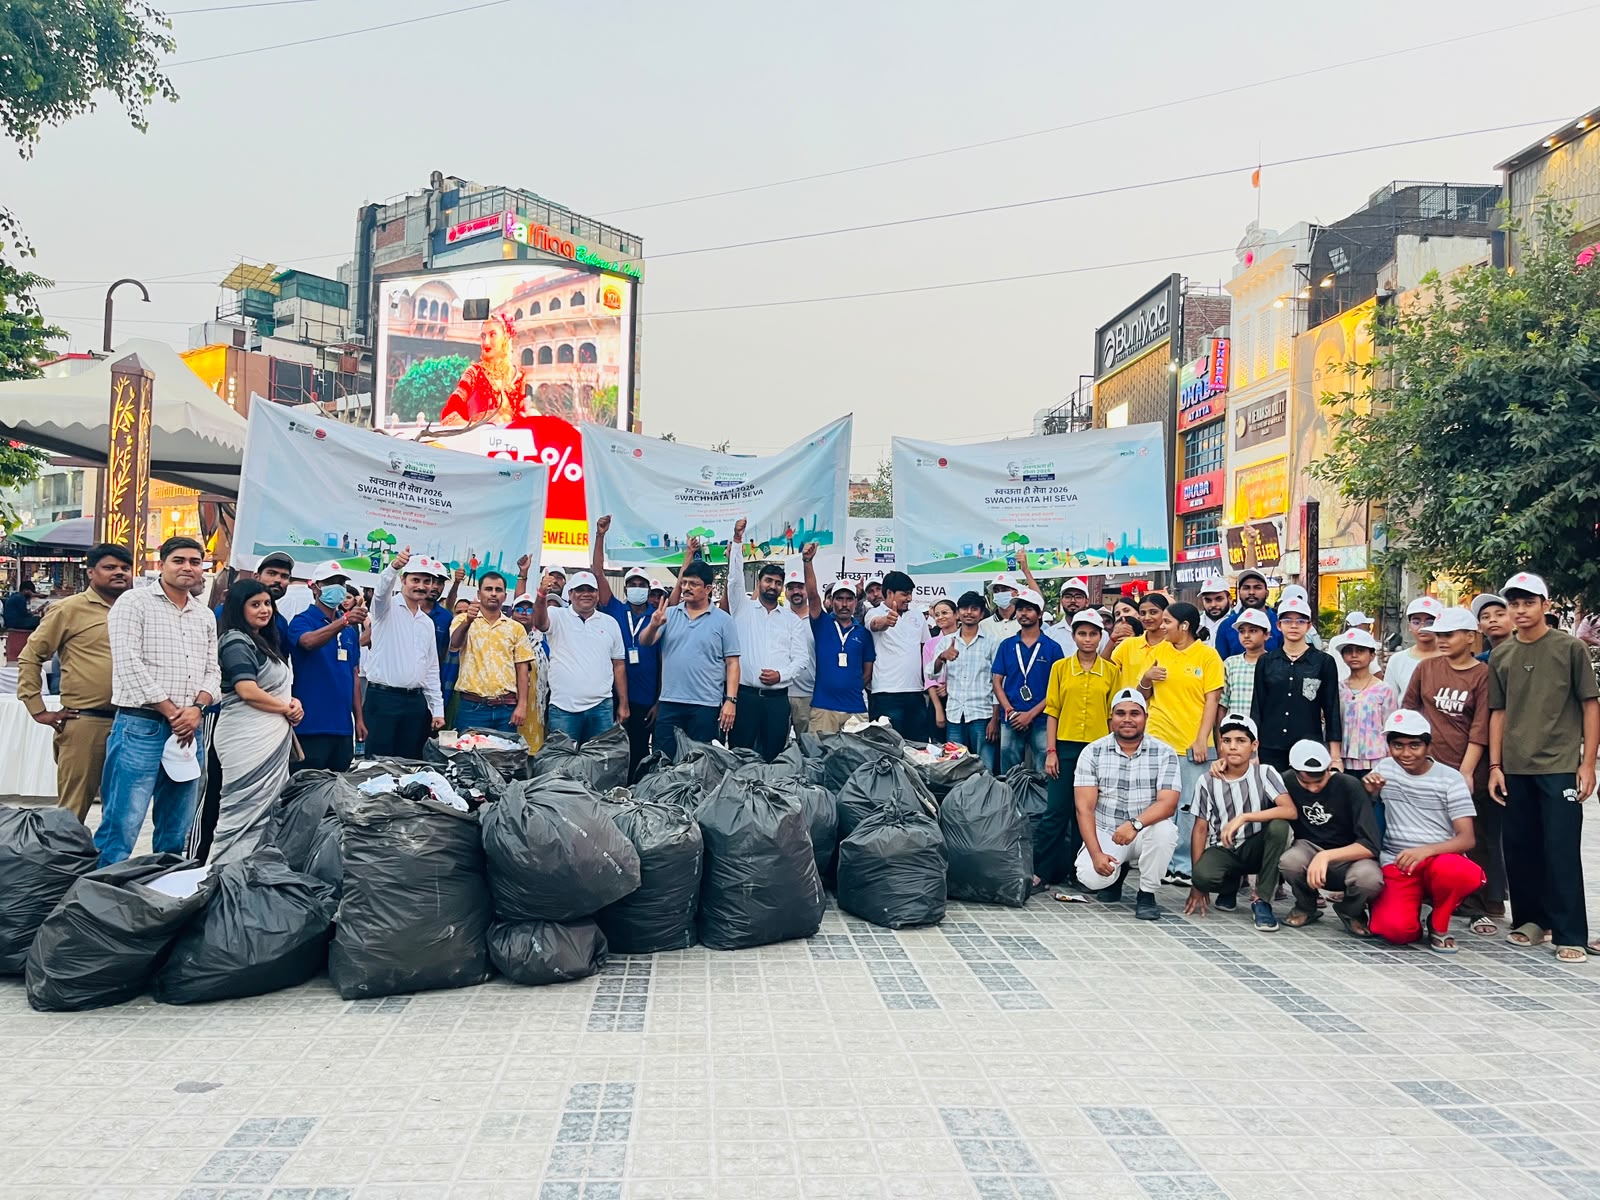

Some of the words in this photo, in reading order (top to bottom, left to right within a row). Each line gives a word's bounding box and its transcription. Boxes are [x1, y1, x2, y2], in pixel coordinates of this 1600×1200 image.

[1115, 289, 1169, 355] Buniyad
[369, 476, 397, 489] स्वच्छता
[398, 481, 407, 491] ही
[407, 483, 422, 494] सेवा
[423, 488, 443, 497] 2026
[1023, 486, 1031, 495] ही
[1032, 485, 1047, 494] सेवा
[1049, 486, 1068, 494] 2026
[1184, 481, 1210, 500] DHABA
[357, 484, 415, 502] SWACHHATA
[417, 496, 427, 504] HI
[428, 498, 453, 509] SEVA
[742, 489, 764, 499] SEVA
[984, 496, 1041, 504] SWACHHATA
[1054, 494, 1078, 503] SEVA
[916, 586, 947, 596] SEVA
